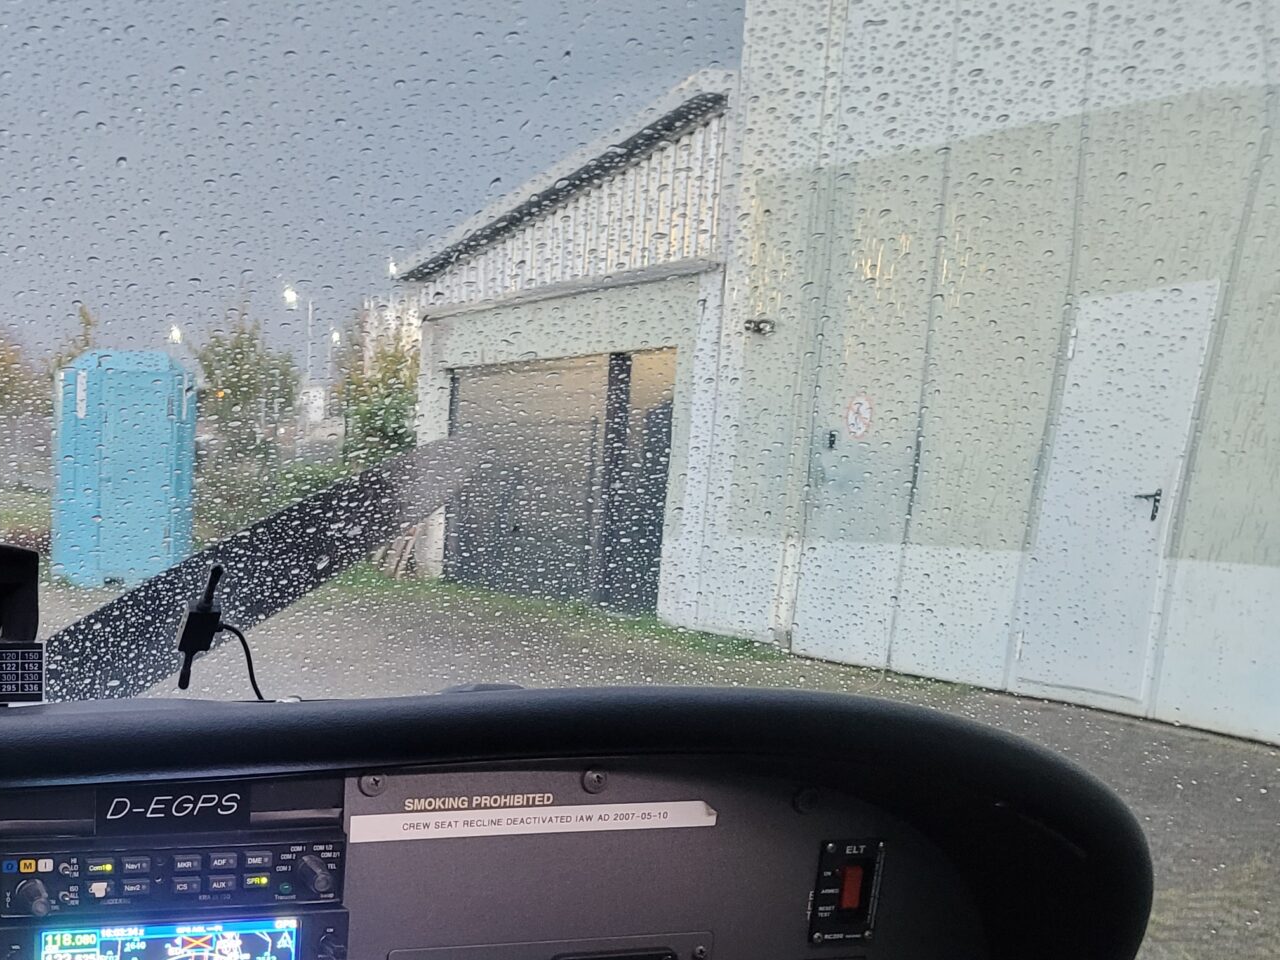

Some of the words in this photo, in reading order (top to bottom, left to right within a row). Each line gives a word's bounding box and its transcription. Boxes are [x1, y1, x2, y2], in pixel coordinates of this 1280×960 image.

[106, 793, 241, 820] D-EGPS
[404, 797, 468, 811] SMOKING
[472, 793, 553, 808] PROHIBITED
[402, 823, 431, 831] CREW
[435, 821, 459, 829] SEAT
[463, 819, 502, 827] RECLINE
[506, 816, 572, 826] DEACTIVATED
[614, 812, 668, 821] 2007-05-10
[845, 845, 866, 854] ELT
[126, 862, 141, 870] Nav1
[213, 858, 227, 866] ADF
